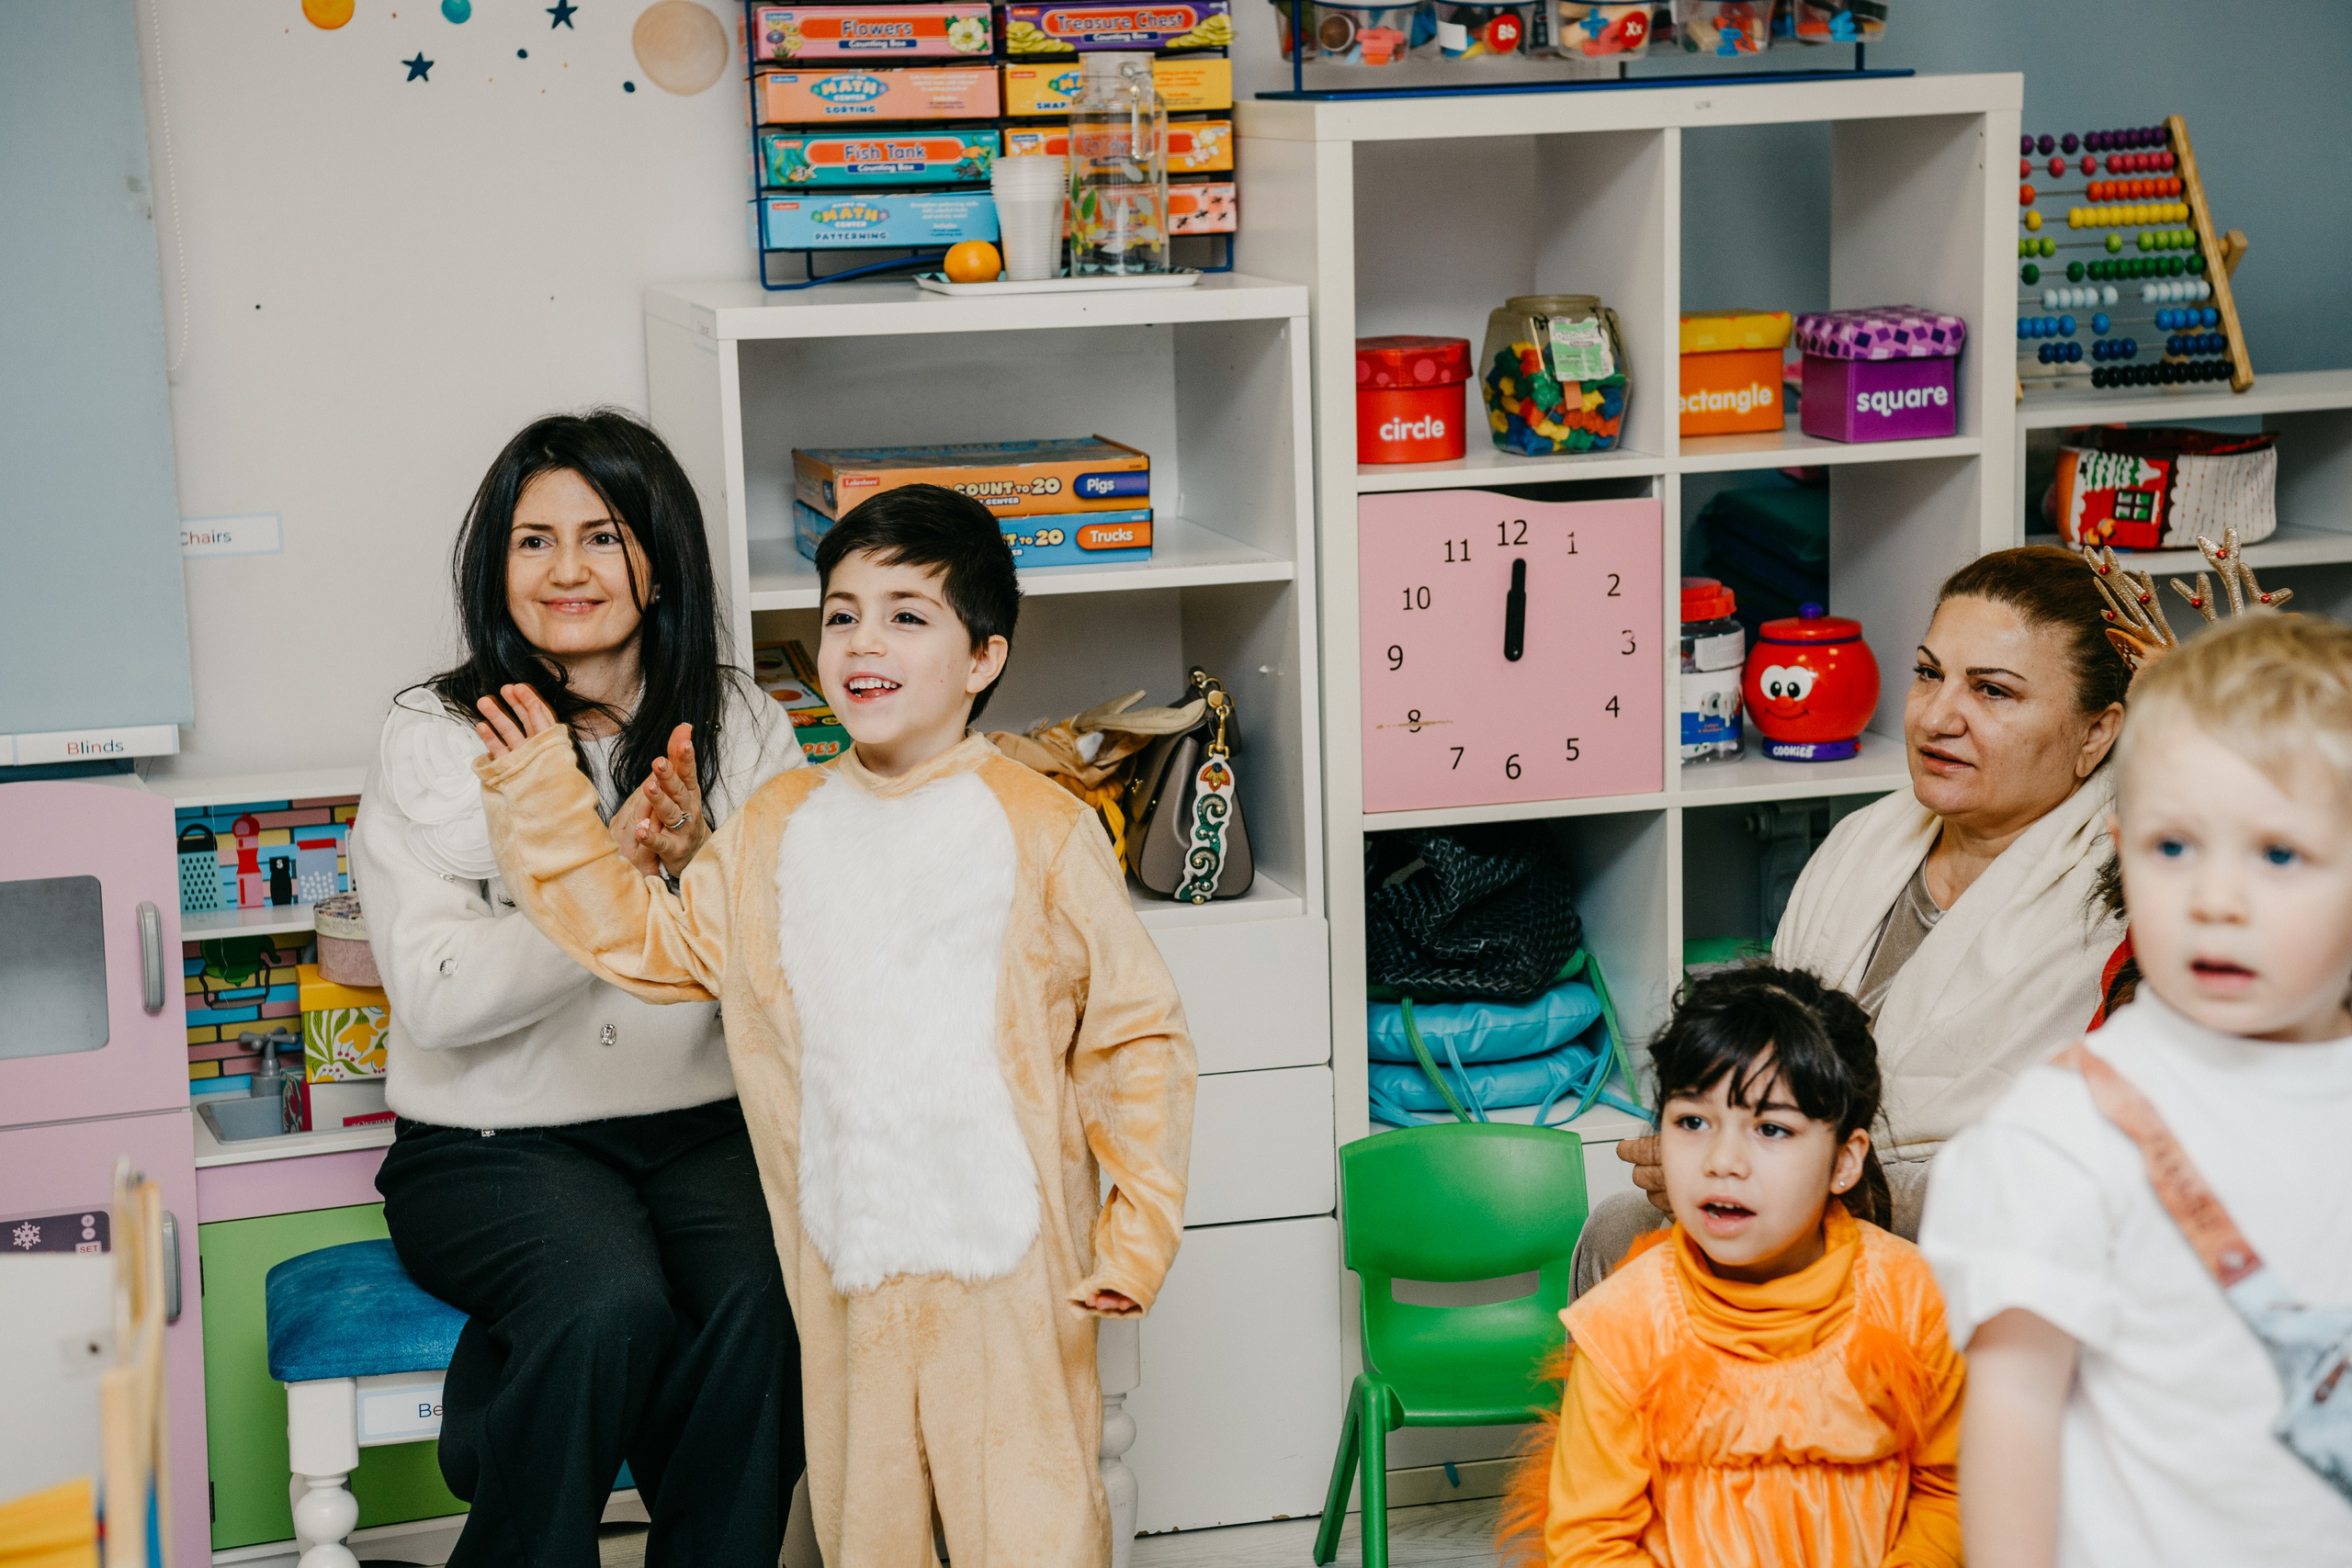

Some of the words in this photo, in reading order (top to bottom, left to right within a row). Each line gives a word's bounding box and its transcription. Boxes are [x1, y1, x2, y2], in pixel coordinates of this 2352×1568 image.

[842, 19, 912, 37] Flowers
[1057, 15, 1131, 30] Treasure
[1136, 13, 1184, 28] Chest
[1625, 21, 1643, 37] Xx
[1092, 33, 1131, 42] Counting
[1131, 32, 1148, 40] Box
[1498, 25, 1517, 40] Bb
[848, 39, 888, 49] Counting
[821, 80, 877, 96] MATH
[824, 106, 876, 114] SORTING
[844, 145, 880, 161] Fish
[885, 144, 926, 159] Tank
[856, 164, 897, 173] Counting
[898, 163, 915, 171] Box
[821, 207, 878, 222] MATH
[1856, 386, 1948, 417] square
[1379, 414, 1445, 441] circle
[845, 477, 878, 486] Lakeshore
[954, 481, 1013, 496] COUNT
[1015, 485, 1030, 493] TO
[1031, 477, 1061, 495] 20
[1086, 478, 1115, 492] Pigs
[180, 529, 232, 547] Chairs
[1019, 536, 1034, 546] TO
[1035, 528, 1064, 547] 20
[1091, 528, 1134, 543] Trucks
[1497, 520, 1529, 547] 12
[1443, 539, 1472, 563] 11
[1566, 531, 1578, 555] 1
[1607, 574, 1621, 597] 2
[1402, 586, 1430, 611] 10
[1621, 630, 1636, 655] 3
[1387, 645, 1404, 671] 9
[1605, 695, 1620, 717] 4
[1407, 709, 1422, 733] 8
[67, 739, 124, 755] Blinds
[802, 741, 840, 756] PES
[1566, 738, 1579, 761] 5
[1772, 746, 1815, 758] COOKIES
[1450, 747, 1464, 770] 7
[1505, 753, 1521, 780] 6
[276, 859, 283, 869] S
[80, 1245, 98, 1253] SET
